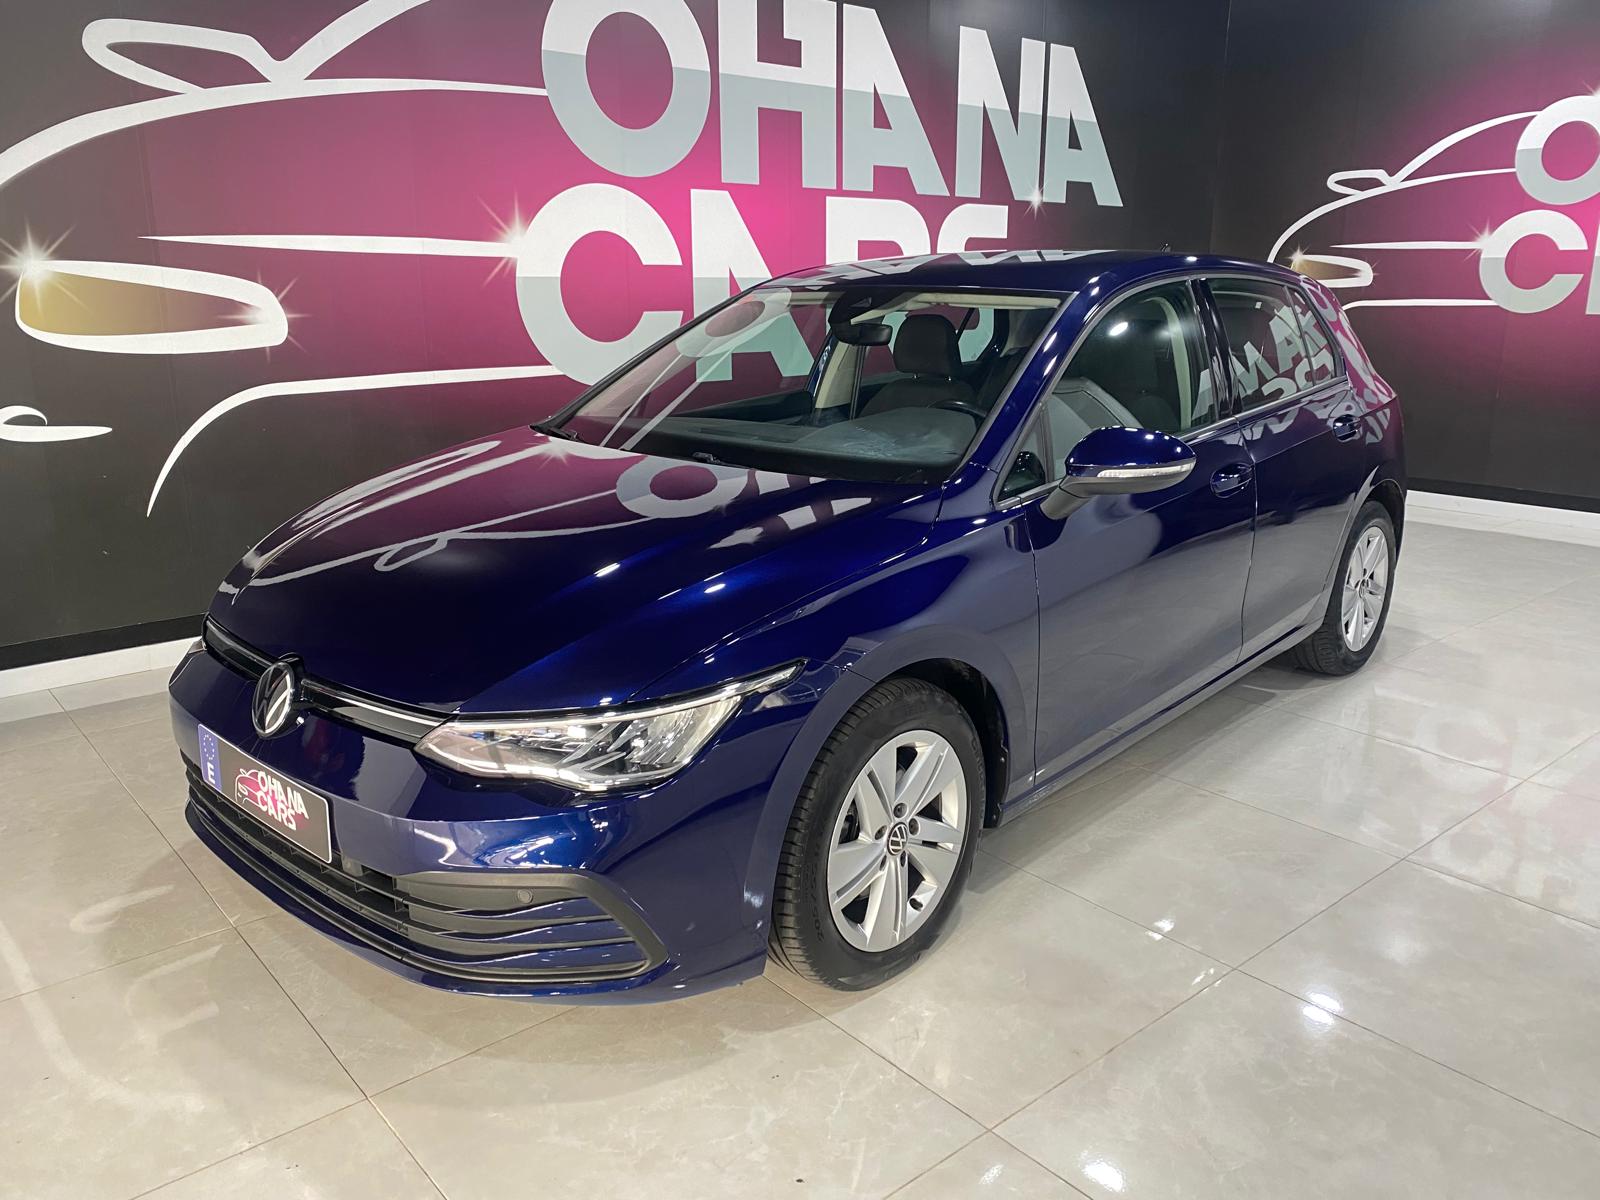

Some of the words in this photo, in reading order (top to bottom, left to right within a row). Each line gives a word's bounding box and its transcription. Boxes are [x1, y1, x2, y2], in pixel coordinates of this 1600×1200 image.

[541, 0, 1124, 207] OHANA
[207, 762, 216, 785] E
[257, 771, 309, 820] OHANA
[257, 792, 297, 831] CARS
